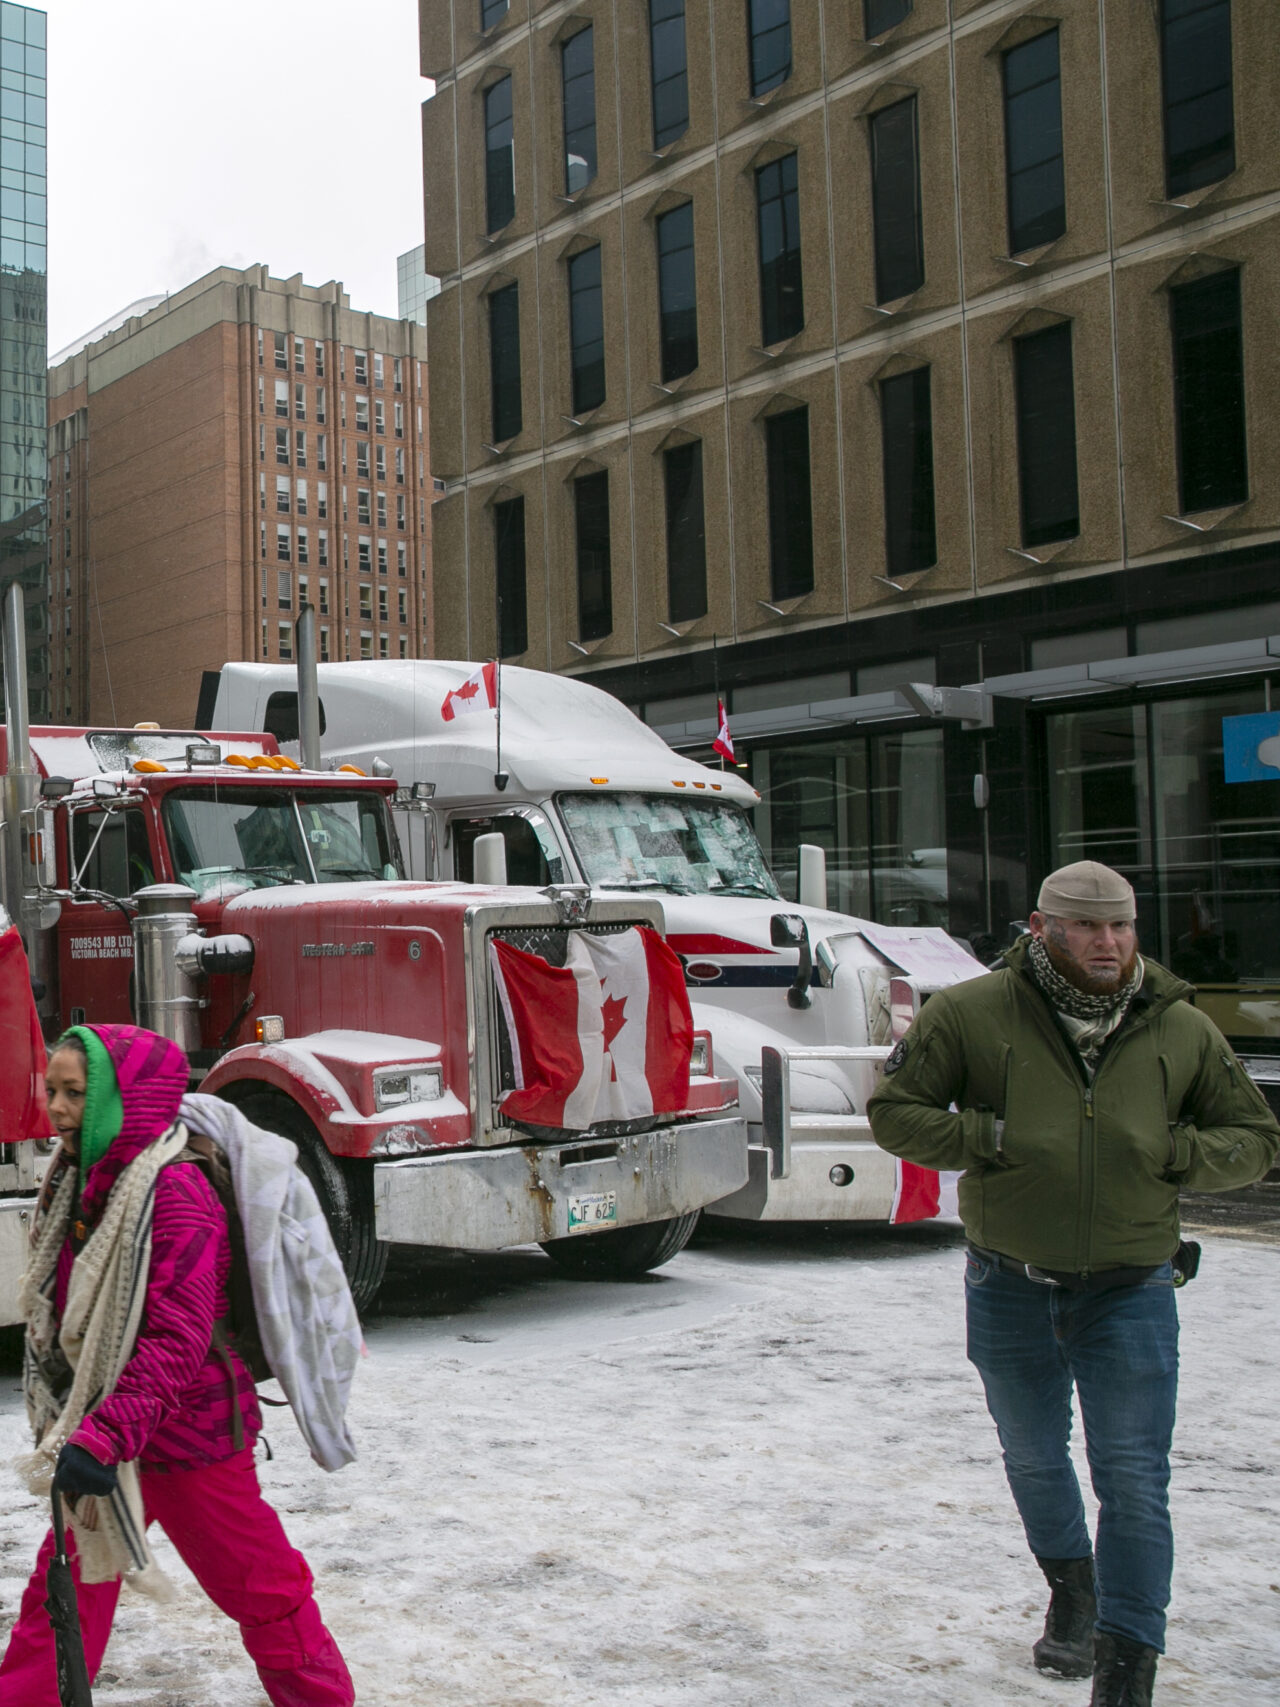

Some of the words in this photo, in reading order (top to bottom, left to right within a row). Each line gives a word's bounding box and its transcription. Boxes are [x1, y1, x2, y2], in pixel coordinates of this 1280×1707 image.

[70, 937, 101, 949] 7009543
[103, 936, 116, 948] MB
[71, 949, 98, 959] VICTORIA
[99, 948, 119, 958] BEACH
[595, 1202, 615, 1219] 625
